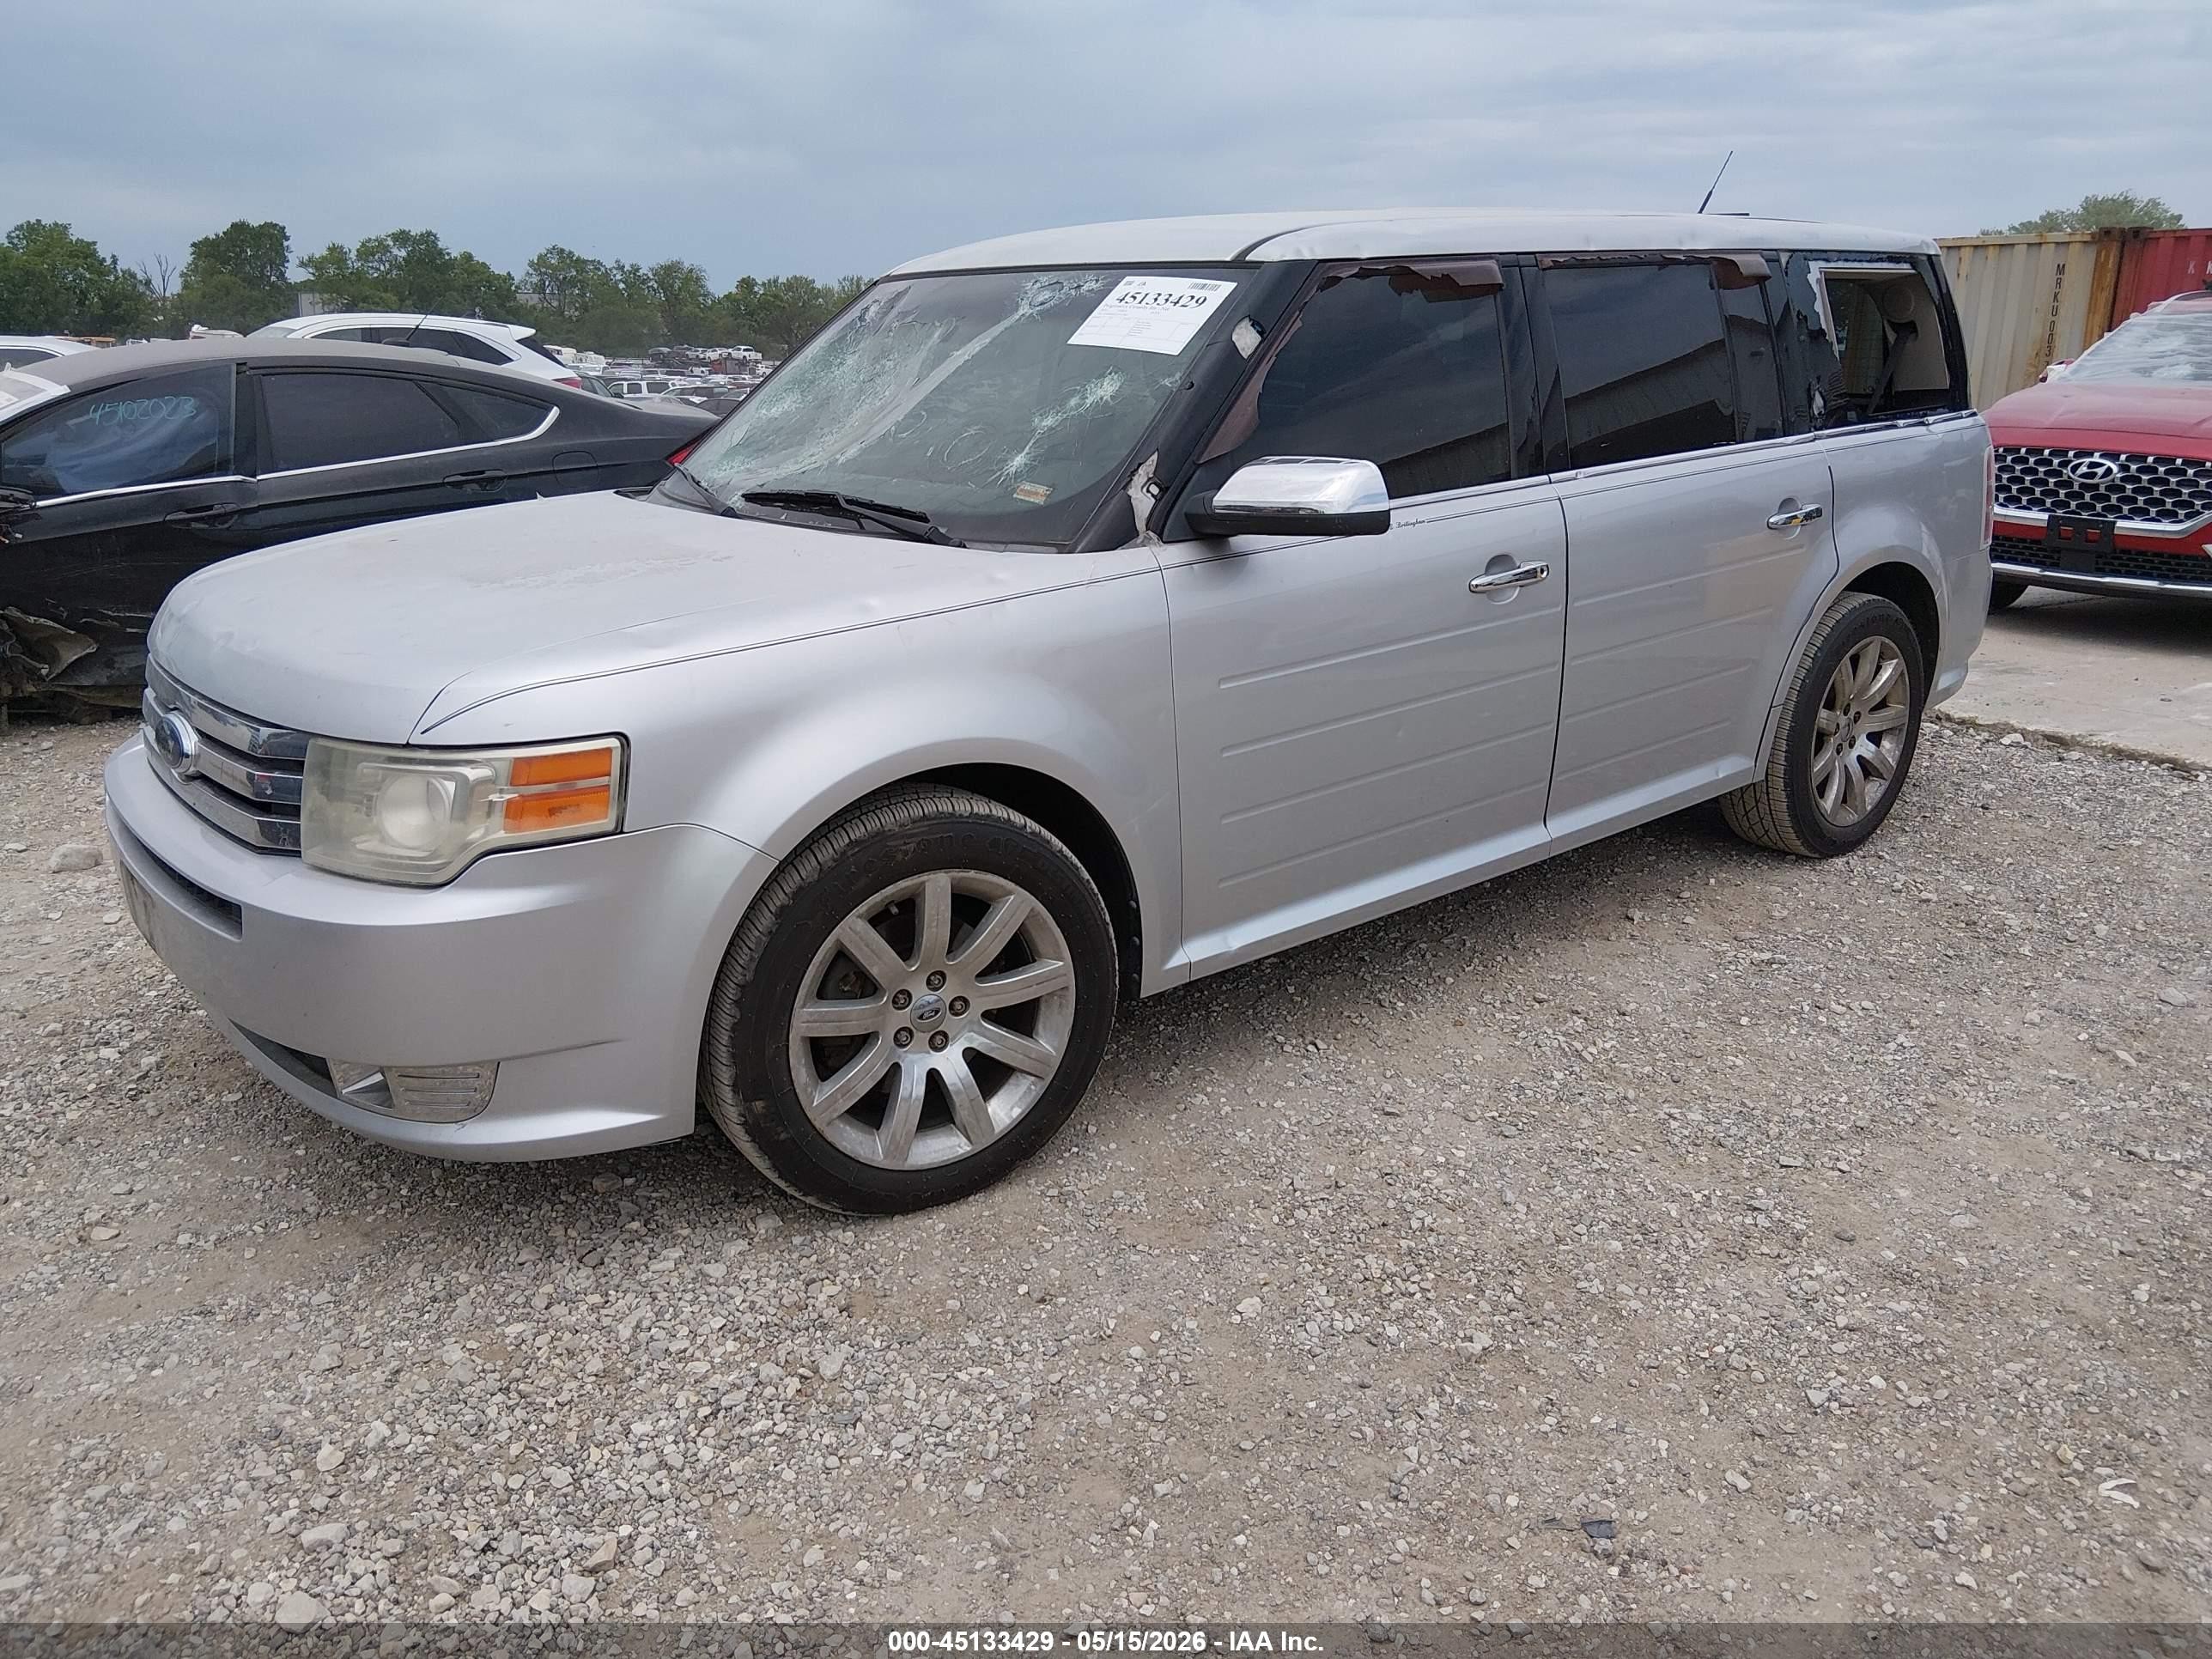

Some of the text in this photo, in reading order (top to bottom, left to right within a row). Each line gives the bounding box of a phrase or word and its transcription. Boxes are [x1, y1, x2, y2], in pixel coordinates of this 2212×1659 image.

[1115, 292, 1207, 308] 45133429
[2051, 263, 2066, 317] MRKU
[89, 396, 197, 426] 45102023
